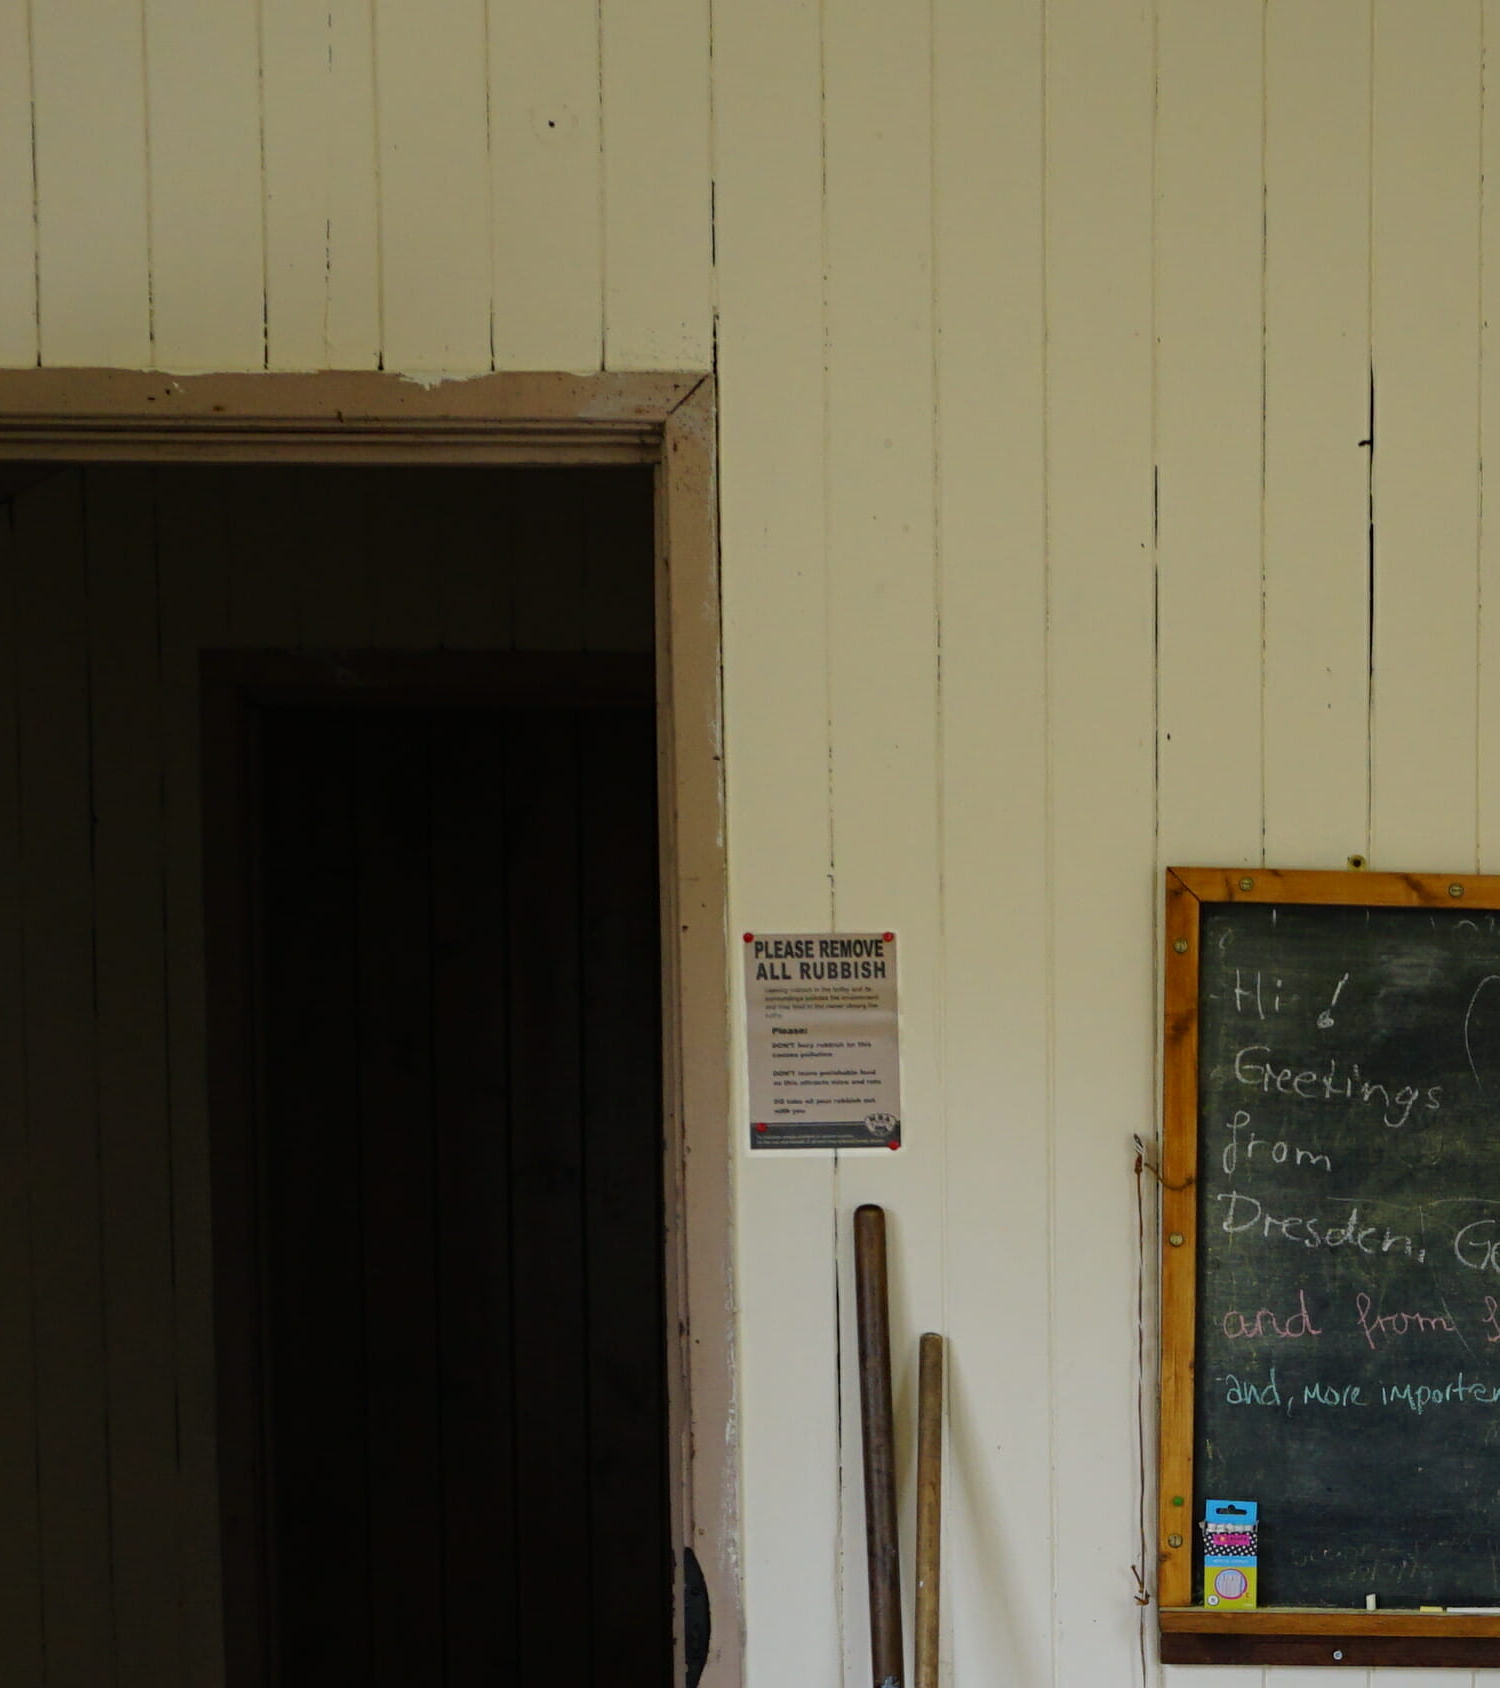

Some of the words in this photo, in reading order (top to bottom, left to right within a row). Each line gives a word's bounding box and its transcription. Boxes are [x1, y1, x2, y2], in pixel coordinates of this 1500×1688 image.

[754, 939, 814, 960] PLEASE
[819, 938, 884, 959] REMOVE
[756, 962, 791, 981] ALL
[800, 961, 886, 980] RUBBISH
[1235, 968, 1283, 1020] Hi
[772, 1027, 808, 1035] Please:
[1233, 1046, 1443, 1129] Greetings
[1222, 1110, 1332, 1173] from
[1223, 1289, 1322, 1341] and
[1356, 1292, 1455, 1350] from
